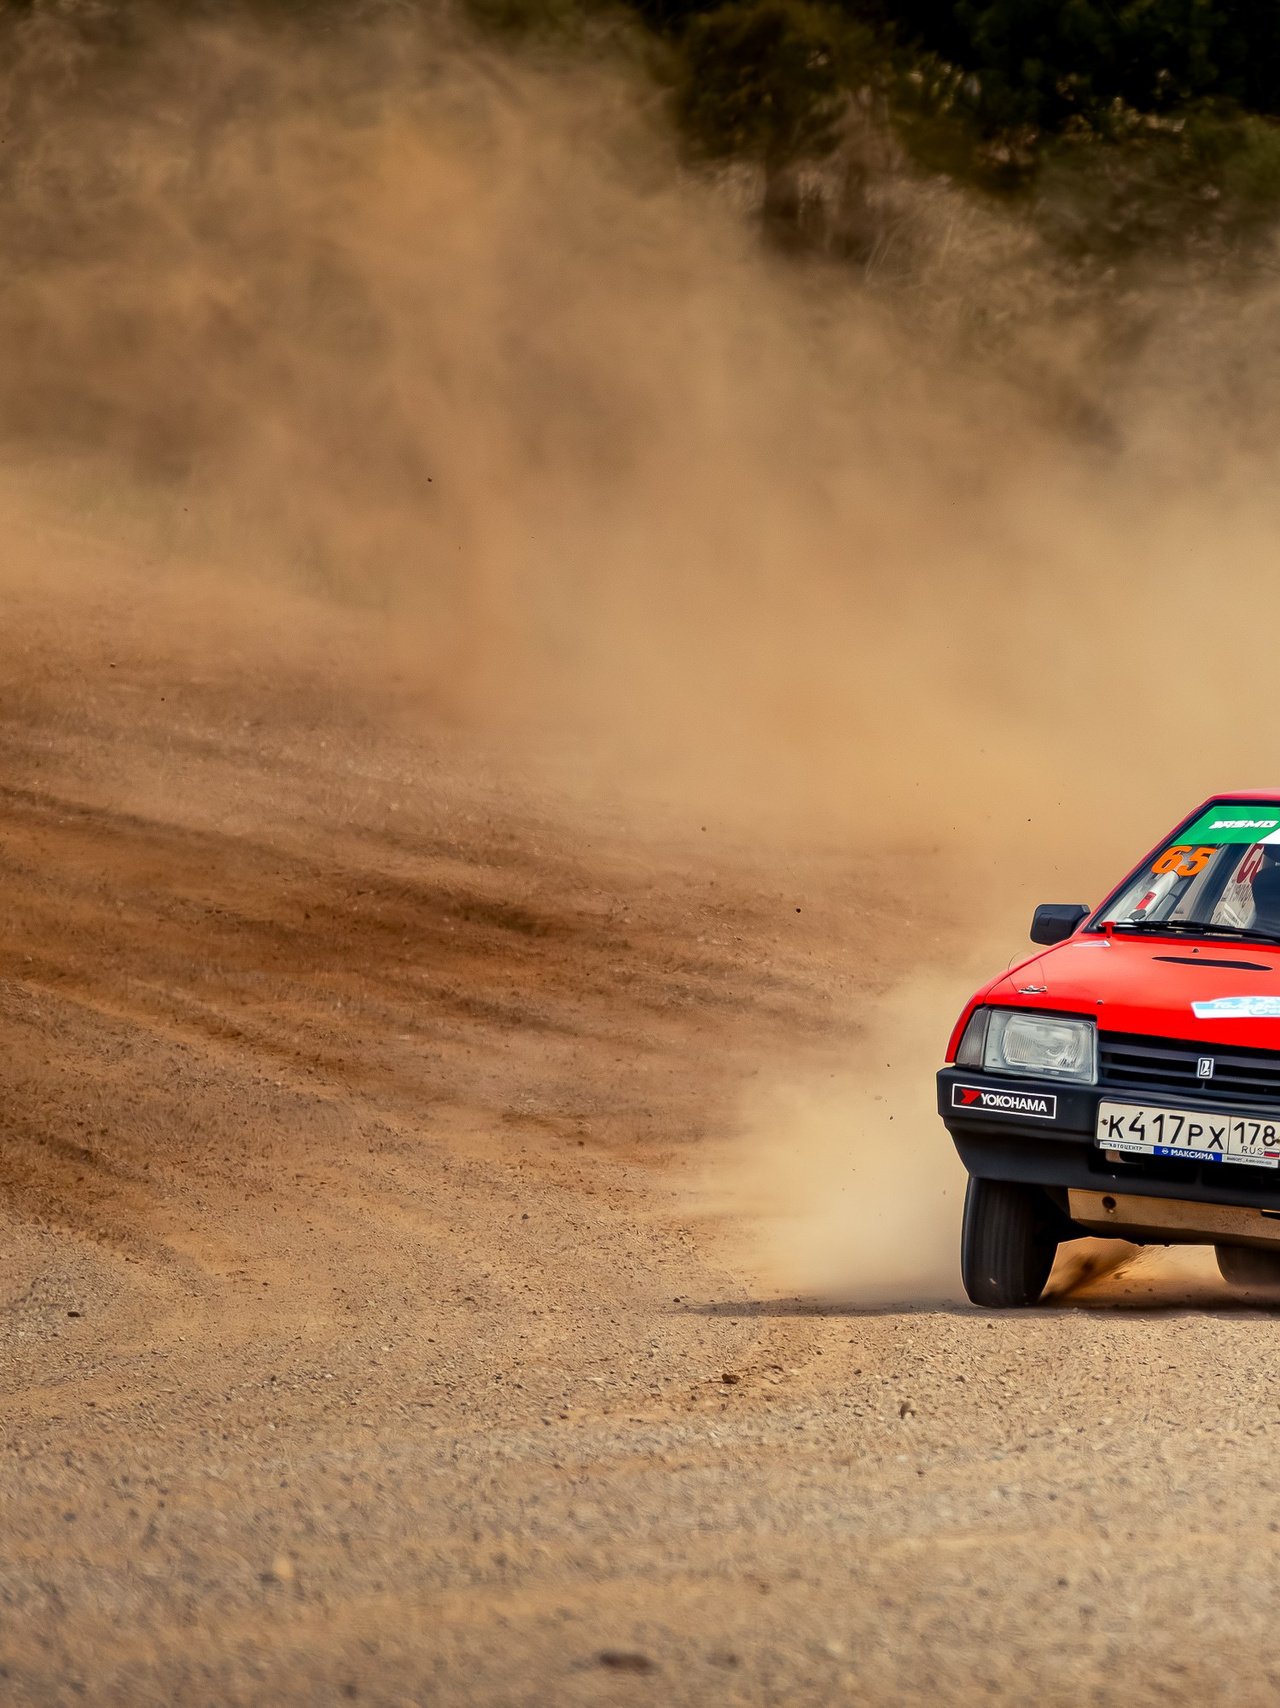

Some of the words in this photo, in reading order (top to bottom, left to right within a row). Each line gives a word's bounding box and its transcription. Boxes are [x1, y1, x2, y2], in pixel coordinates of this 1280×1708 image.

[1151, 845, 1218, 877] 65
[981, 1093, 1048, 1112] YOKOHAMA
[1233, 1121, 1277, 1147] 178
[1170, 1148, 1215, 1161] МАКСИМА
[1241, 1145, 1264, 1156] RUS
